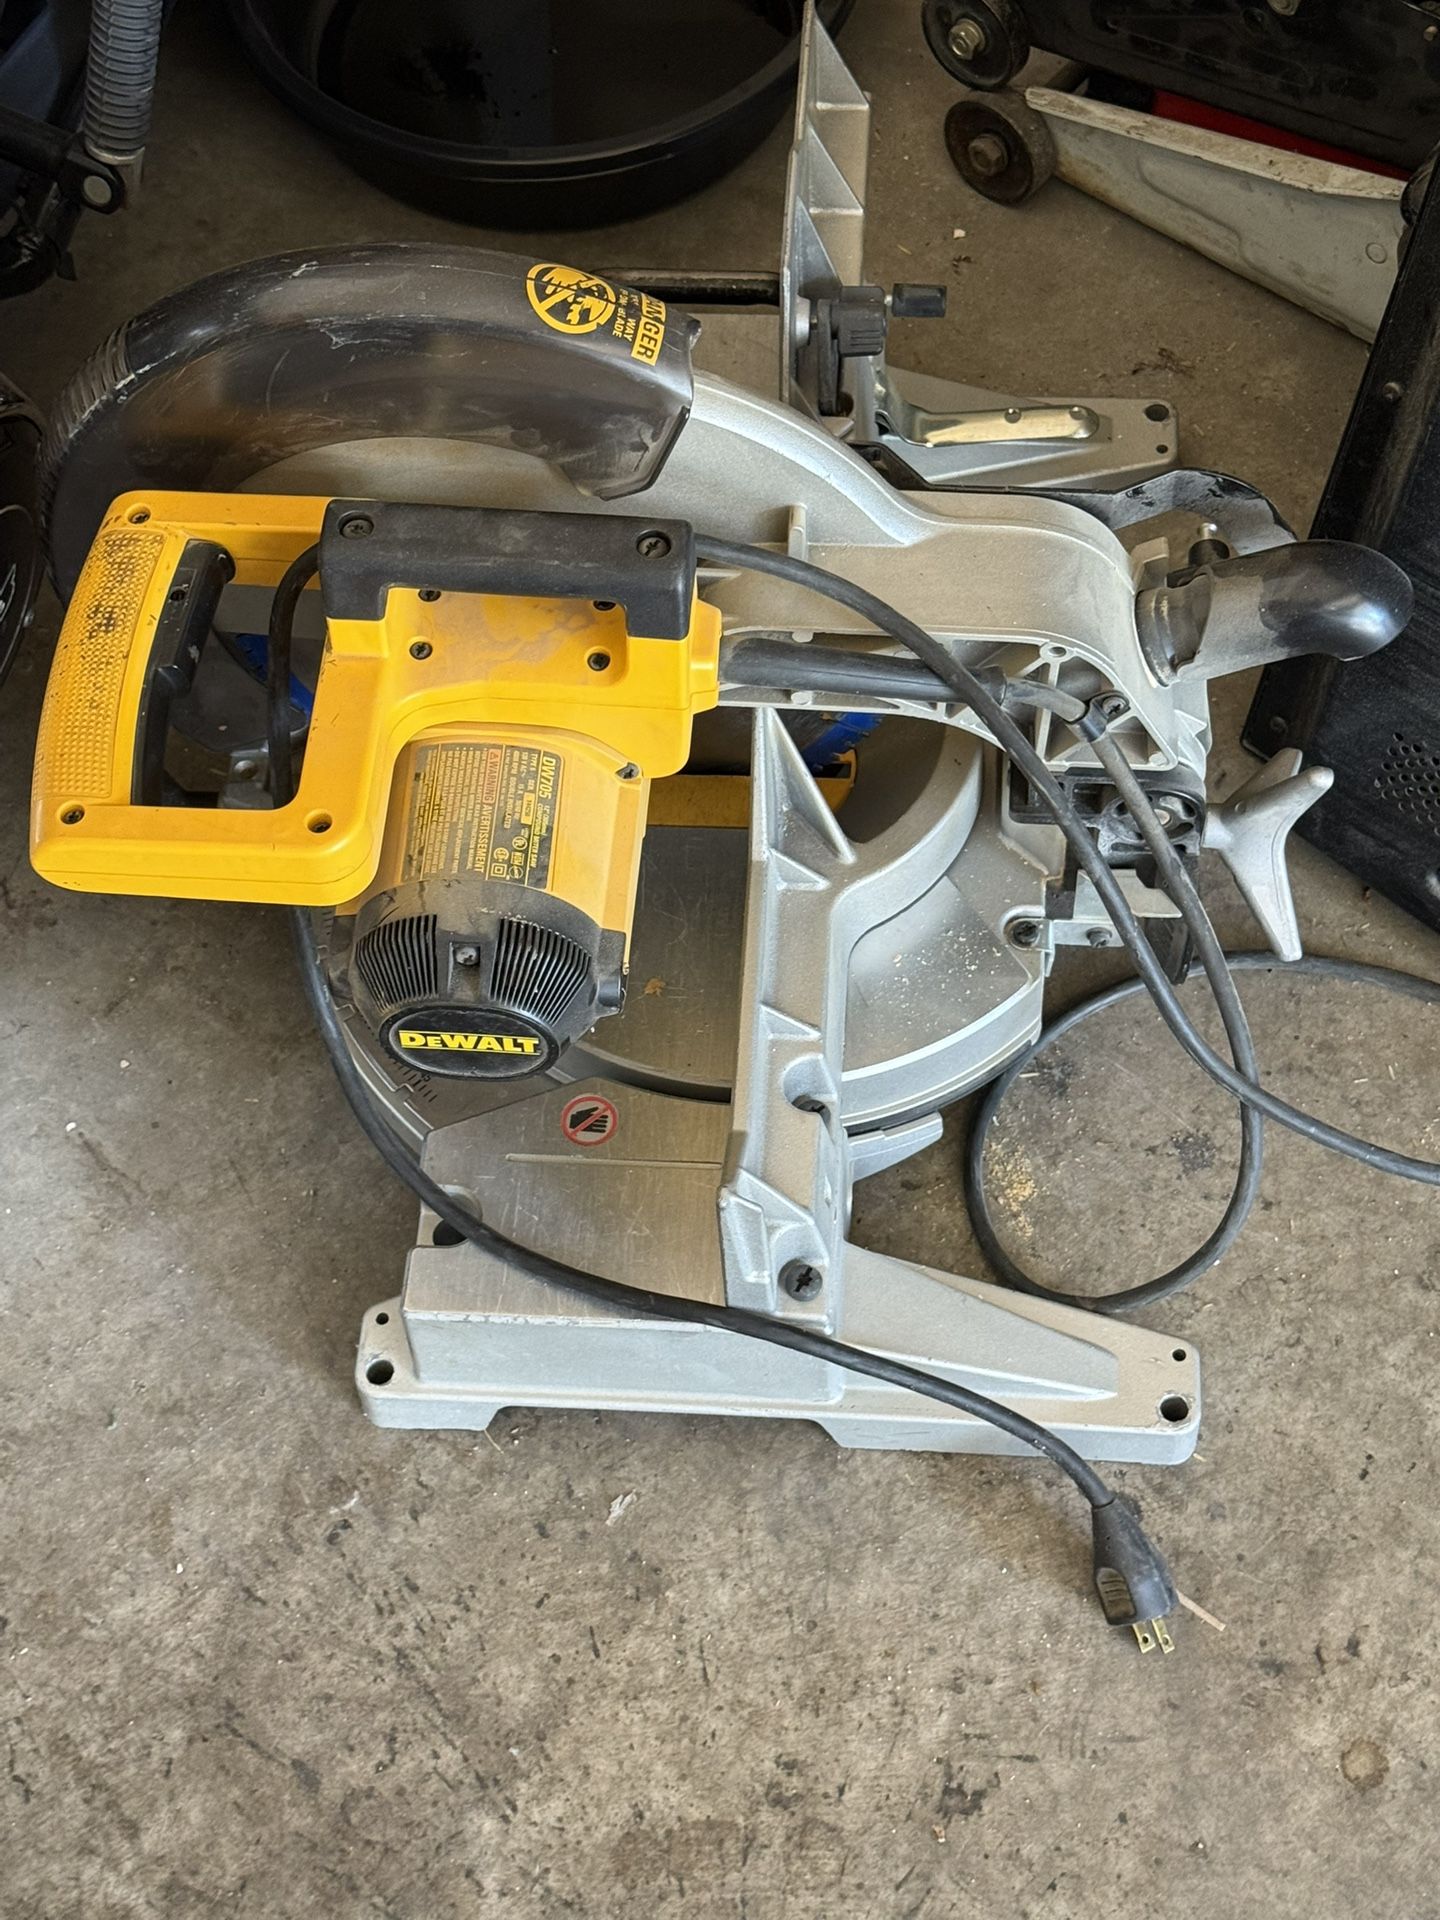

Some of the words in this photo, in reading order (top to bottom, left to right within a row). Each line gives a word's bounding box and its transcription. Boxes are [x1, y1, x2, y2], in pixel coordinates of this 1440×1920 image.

[511, 762, 519, 774] RPM
[530, 753, 538, 767] TYPE
[484, 761, 498, 801] WARNING
[507, 777, 517, 797] DOUBLE
[538, 756, 556, 799] DW705
[503, 797, 514, 829] INSULATED
[534, 803, 544, 835] COMPOUND
[474, 805, 493, 873] AVERTISSEMENT
[531, 836, 540, 853] MITER
[529, 854, 537, 868] SAW
